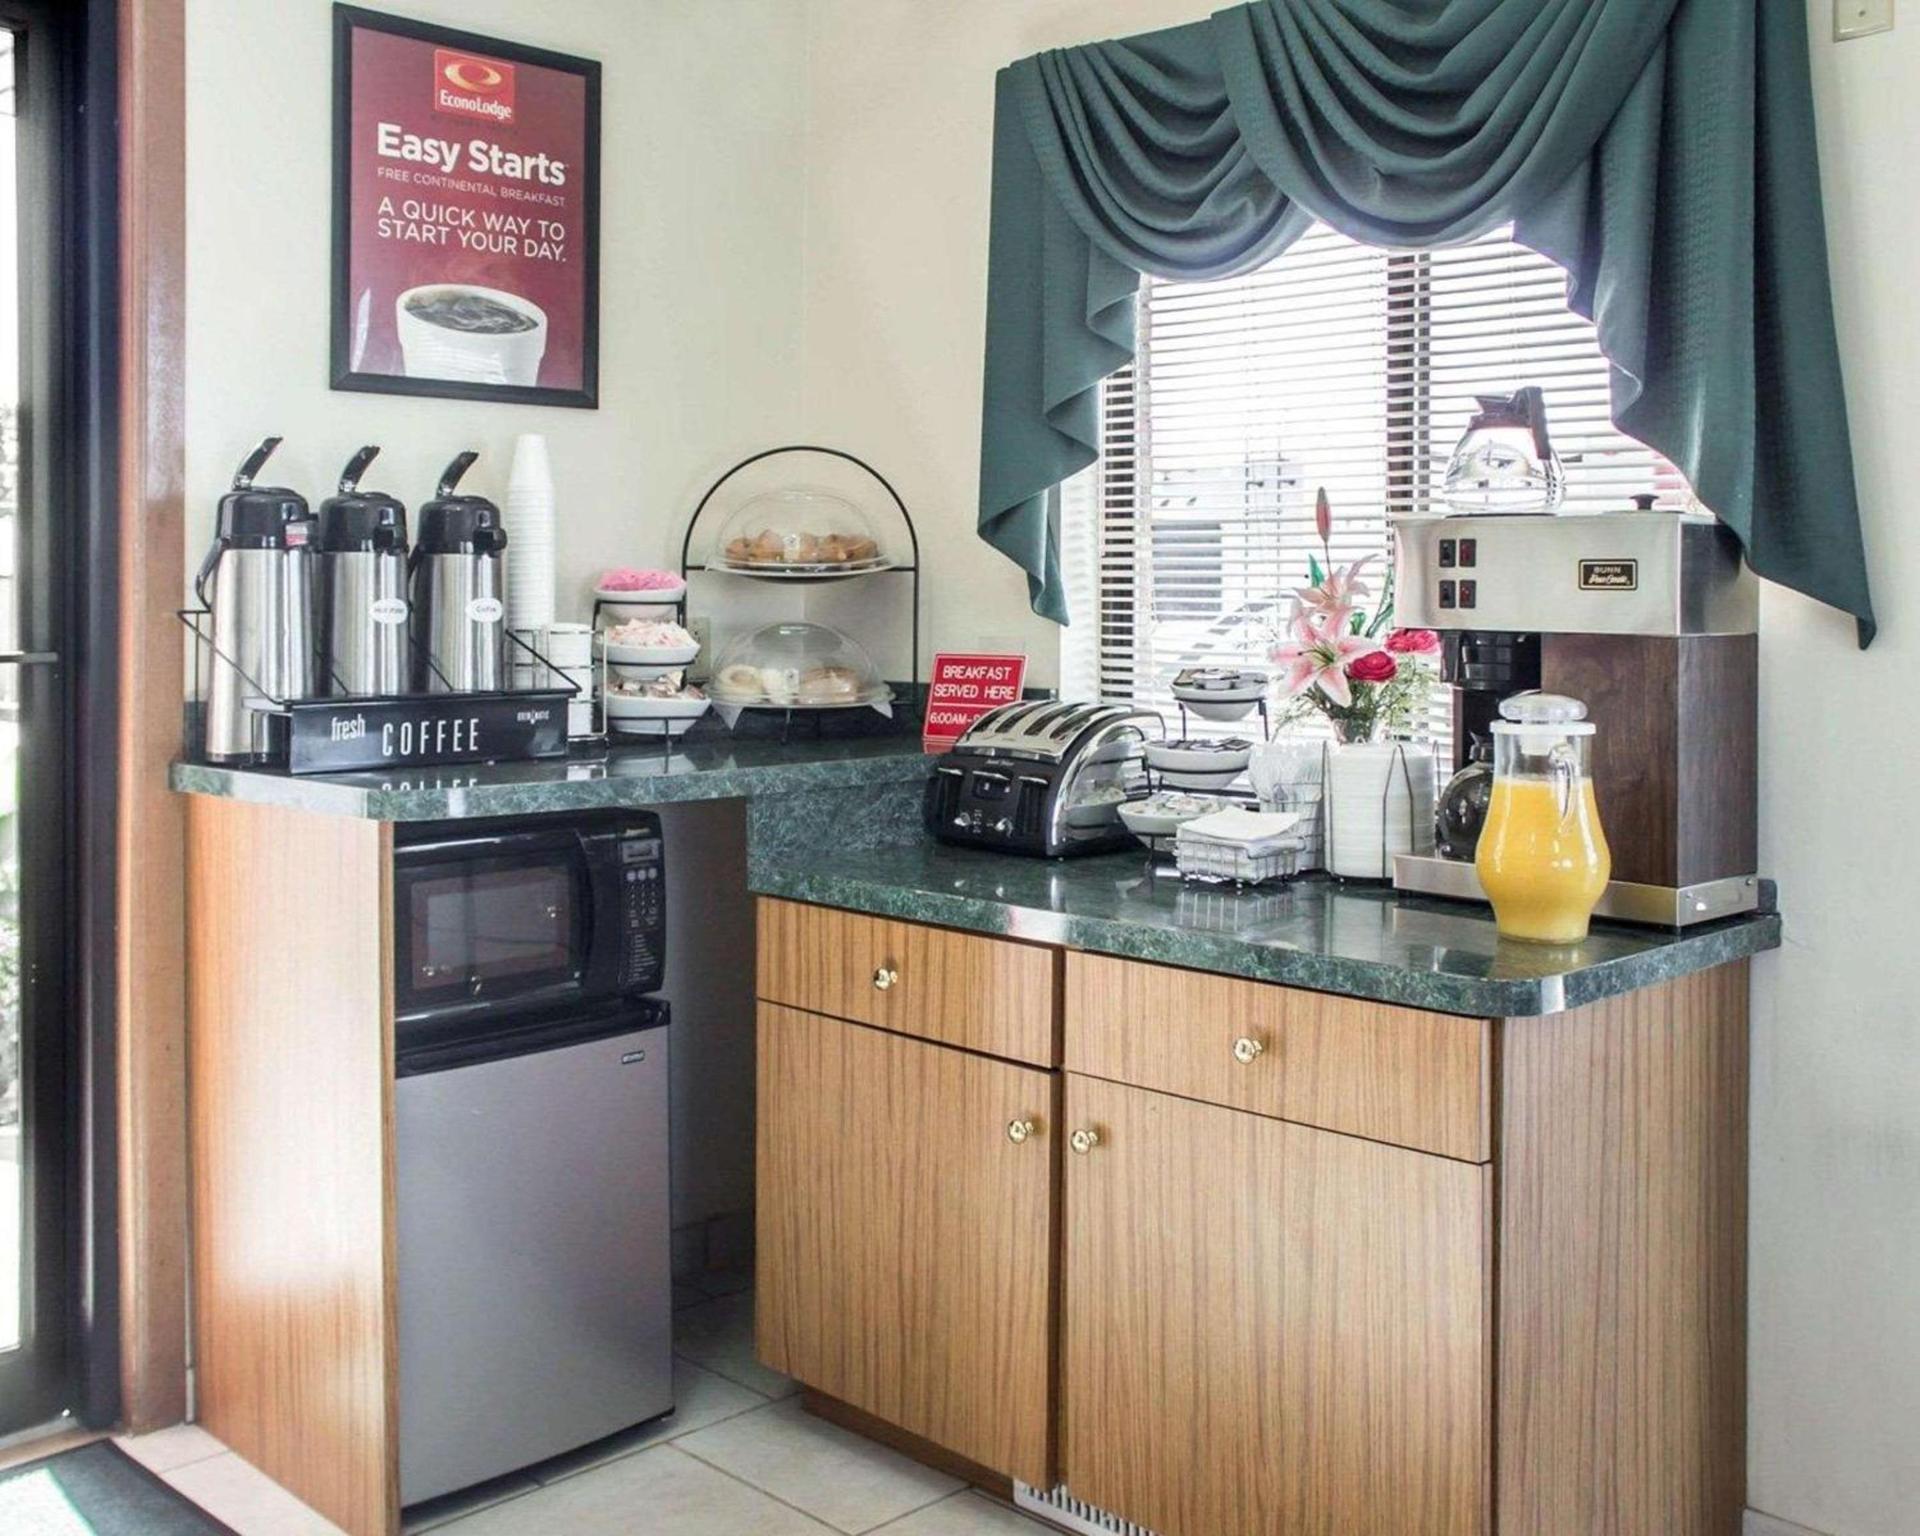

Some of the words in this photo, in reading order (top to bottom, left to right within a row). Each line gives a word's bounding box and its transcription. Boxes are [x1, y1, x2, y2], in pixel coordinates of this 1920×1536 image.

[440, 89, 512, 119] EconoLodge
[377, 122, 461, 173] Easy
[468, 139, 566, 186] Starts
[377, 167, 410, 183] FREE
[414, 174, 497, 196] CONTINENTAL
[500, 187, 565, 206] BREAKFAST
[378, 196, 395, 216] A
[402, 200, 475, 228] QUICK
[482, 211, 531, 235] WAY
[537, 220, 565, 241] TO
[378, 218, 450, 245] START
[457, 229, 517, 255] YOUR
[524, 239, 567, 262] DAY.
[933, 683, 979, 698] SERVED
[983, 685, 1016, 700] HERE
[943, 665, 1012, 680] BREAKFAST
[331, 714, 366, 742] fresh
[382, 718, 479, 756] COFFEE
